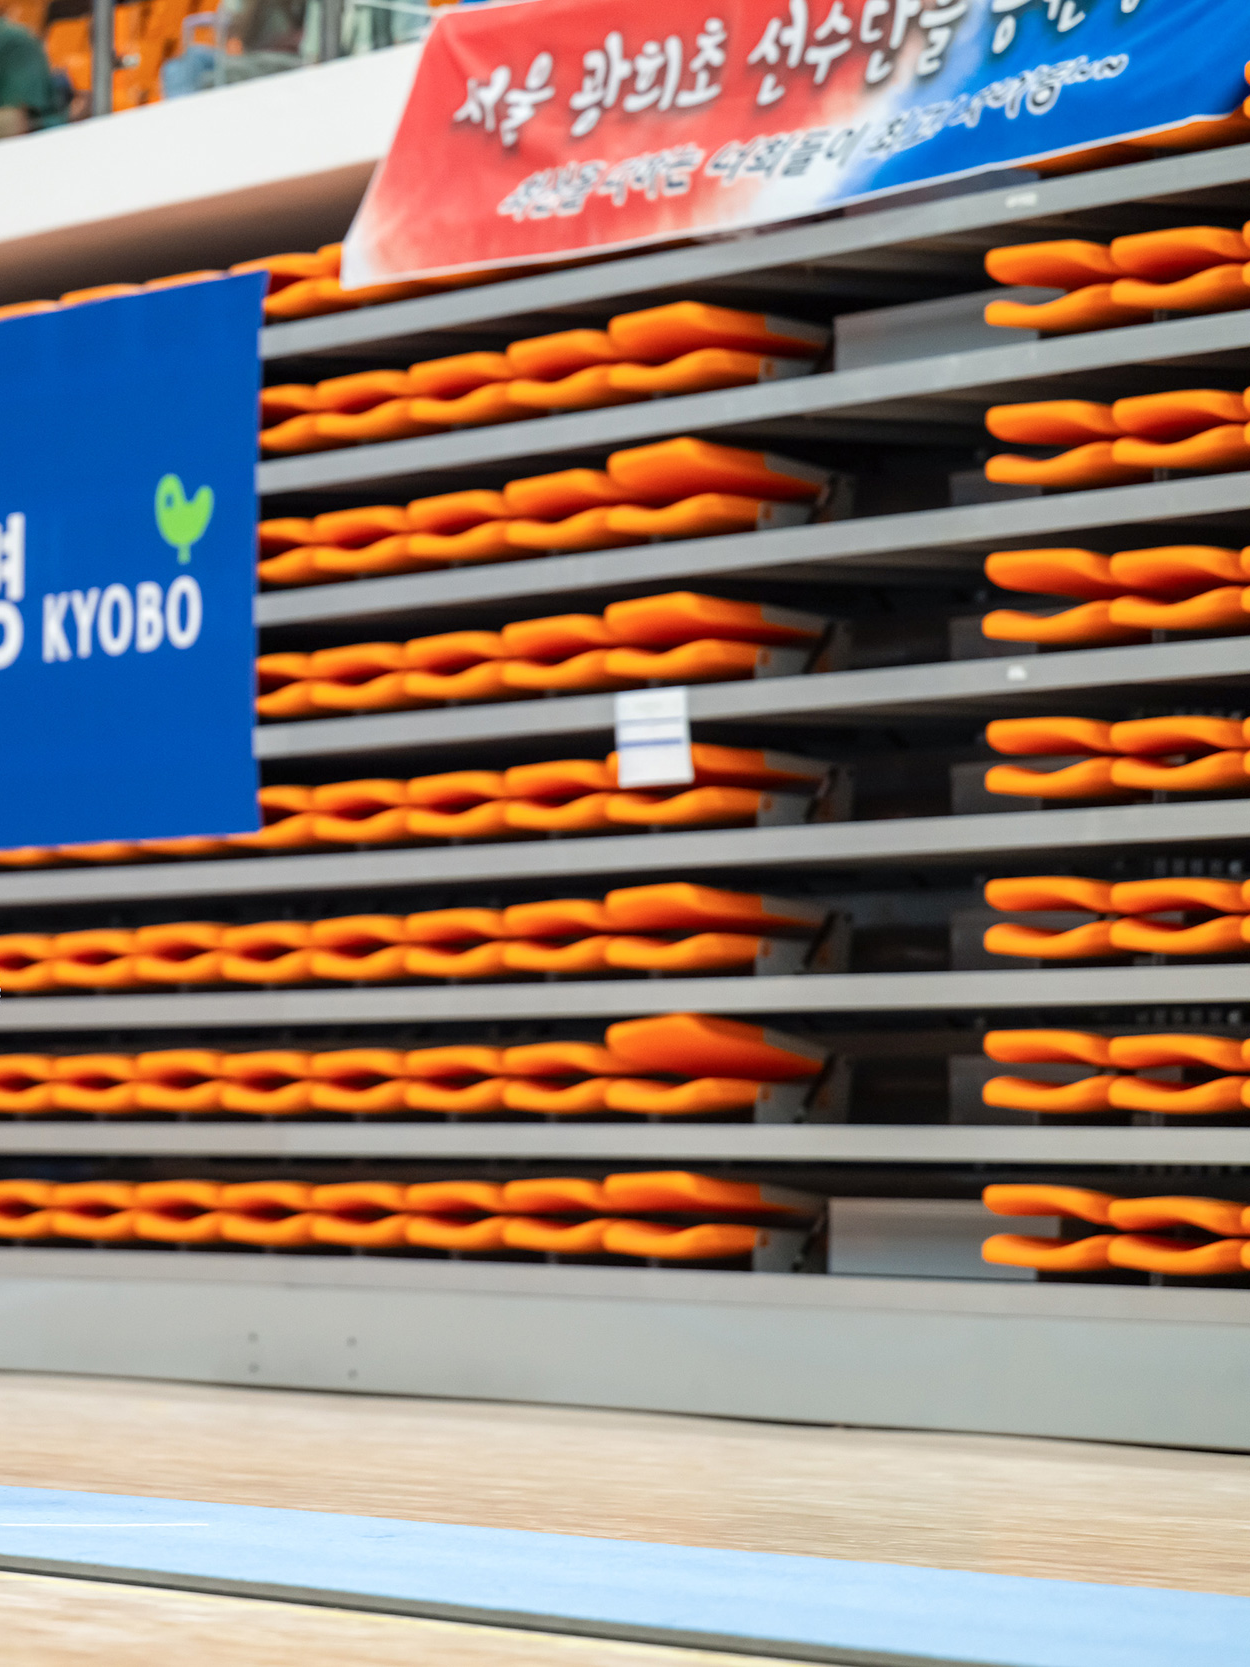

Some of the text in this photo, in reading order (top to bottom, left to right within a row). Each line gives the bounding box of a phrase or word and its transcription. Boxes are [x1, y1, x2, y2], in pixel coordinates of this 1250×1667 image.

[452, 52, 555, 147] 서울
[568, 17, 727, 137] 광희초
[42, 574, 203, 664] KYOBO
